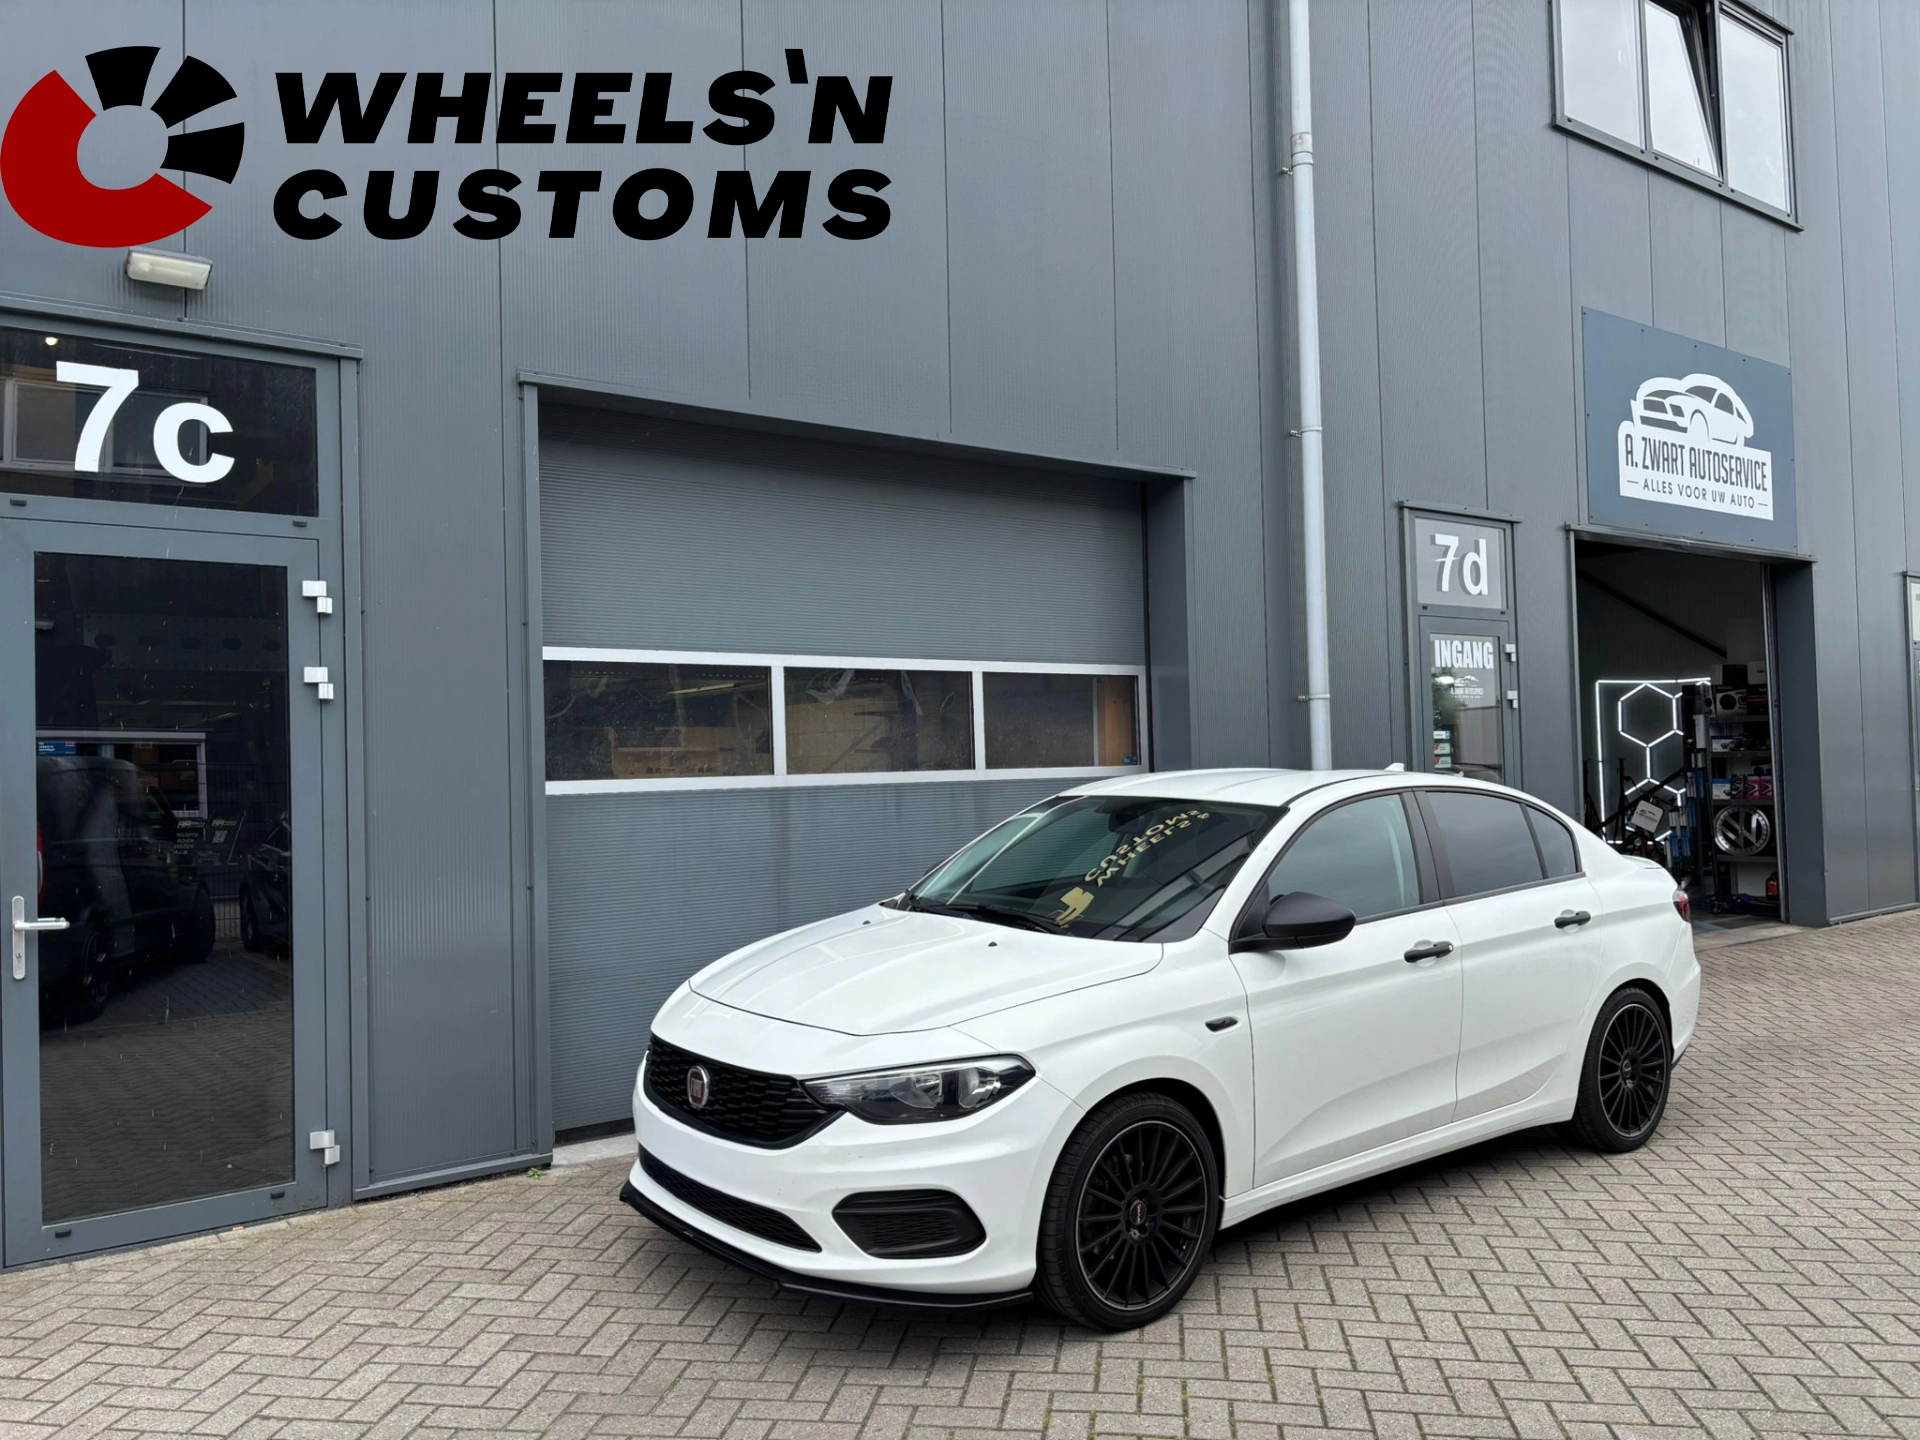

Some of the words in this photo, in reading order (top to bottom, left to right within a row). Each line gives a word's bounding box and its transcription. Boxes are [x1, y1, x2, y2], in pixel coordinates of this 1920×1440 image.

[1625, 433, 1639, 469] A.
[1641, 436, 1686, 477] ZWART
[1689, 446, 1768, 492] AUTOSERVICE
[1643, 478, 1673, 495] ALLES
[1678, 484, 1707, 501] VOOR
[1711, 490, 1726, 504] UW
[1730, 494, 1755, 509] AUTO
[1434, 639, 1494, 670] INGANG
